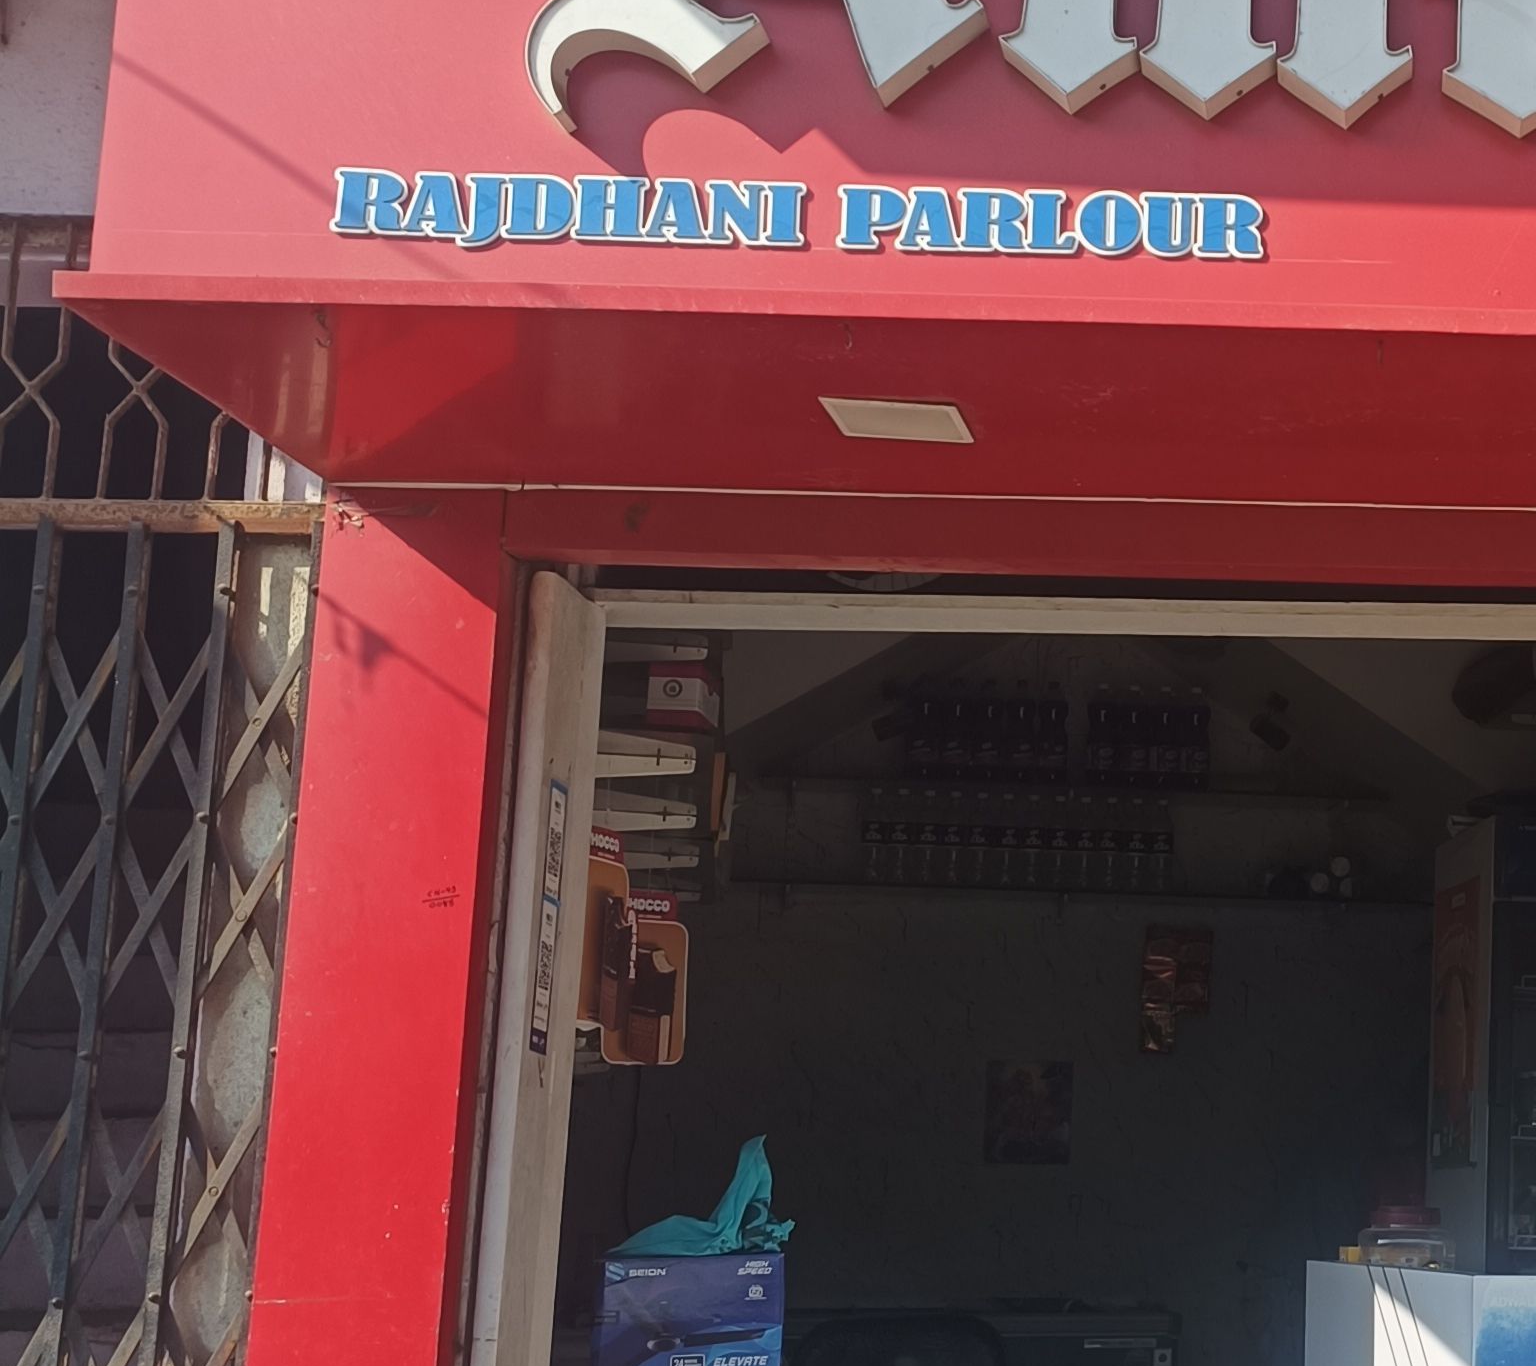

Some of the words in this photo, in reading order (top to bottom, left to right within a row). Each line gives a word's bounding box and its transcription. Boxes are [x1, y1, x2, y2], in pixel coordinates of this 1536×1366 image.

[330, 166, 807, 249] RAJDHANI
[836, 183, 1266, 261] PARLOUR
[626, 897, 671, 912] HOCCO
[736, 1266, 773, 1276] SPEED
